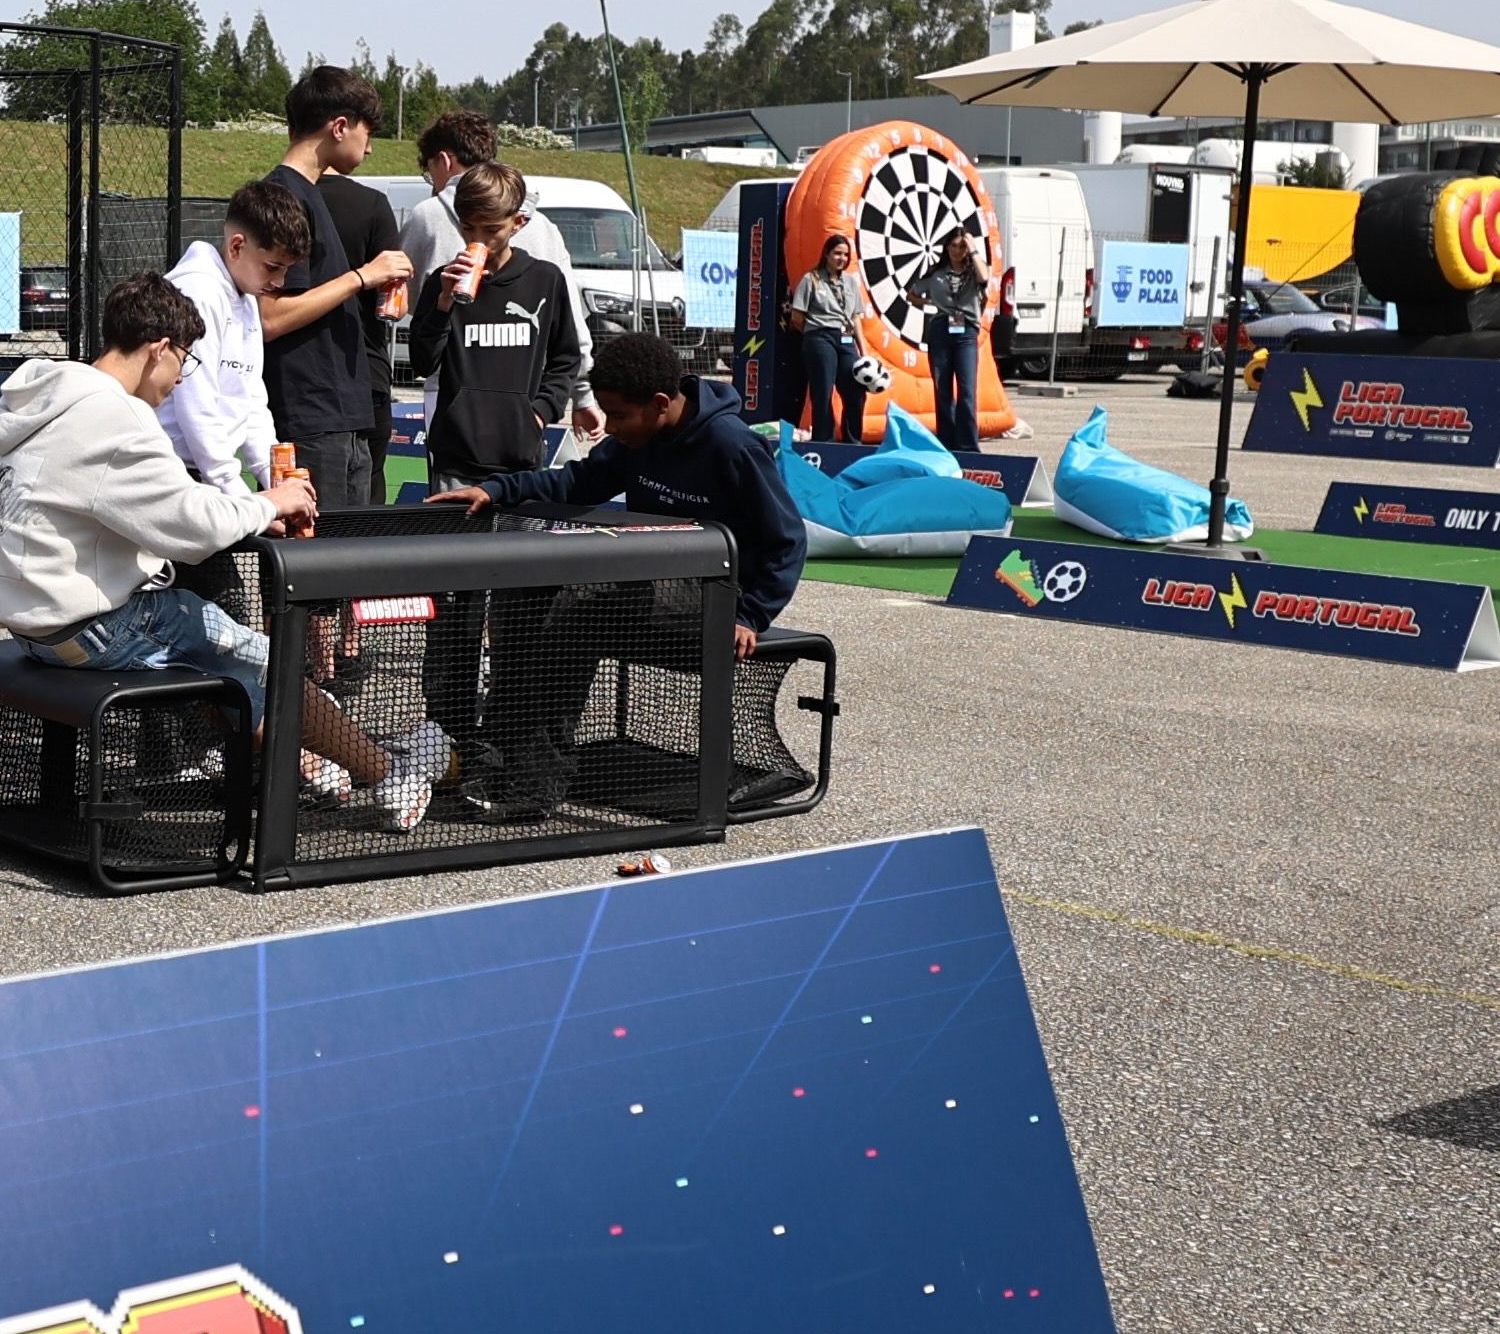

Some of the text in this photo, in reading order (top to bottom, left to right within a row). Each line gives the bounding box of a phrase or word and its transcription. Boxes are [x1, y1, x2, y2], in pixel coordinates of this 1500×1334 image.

[1140, 269, 1173, 284] FOOD
[1138, 289, 1178, 304] PLAZA
[745, 218, 763, 410] LIGA PORTUGAL
[465, 323, 530, 347] PUMA
[1341, 381, 1404, 404] LIGA
[1333, 402, 1473, 431] PORTUGAL
[638, 475, 667, 493] TOMMY
[1445, 508, 1490, 531] ONLY
[1142, 578, 1420, 636] LIGA PORTUGAL
